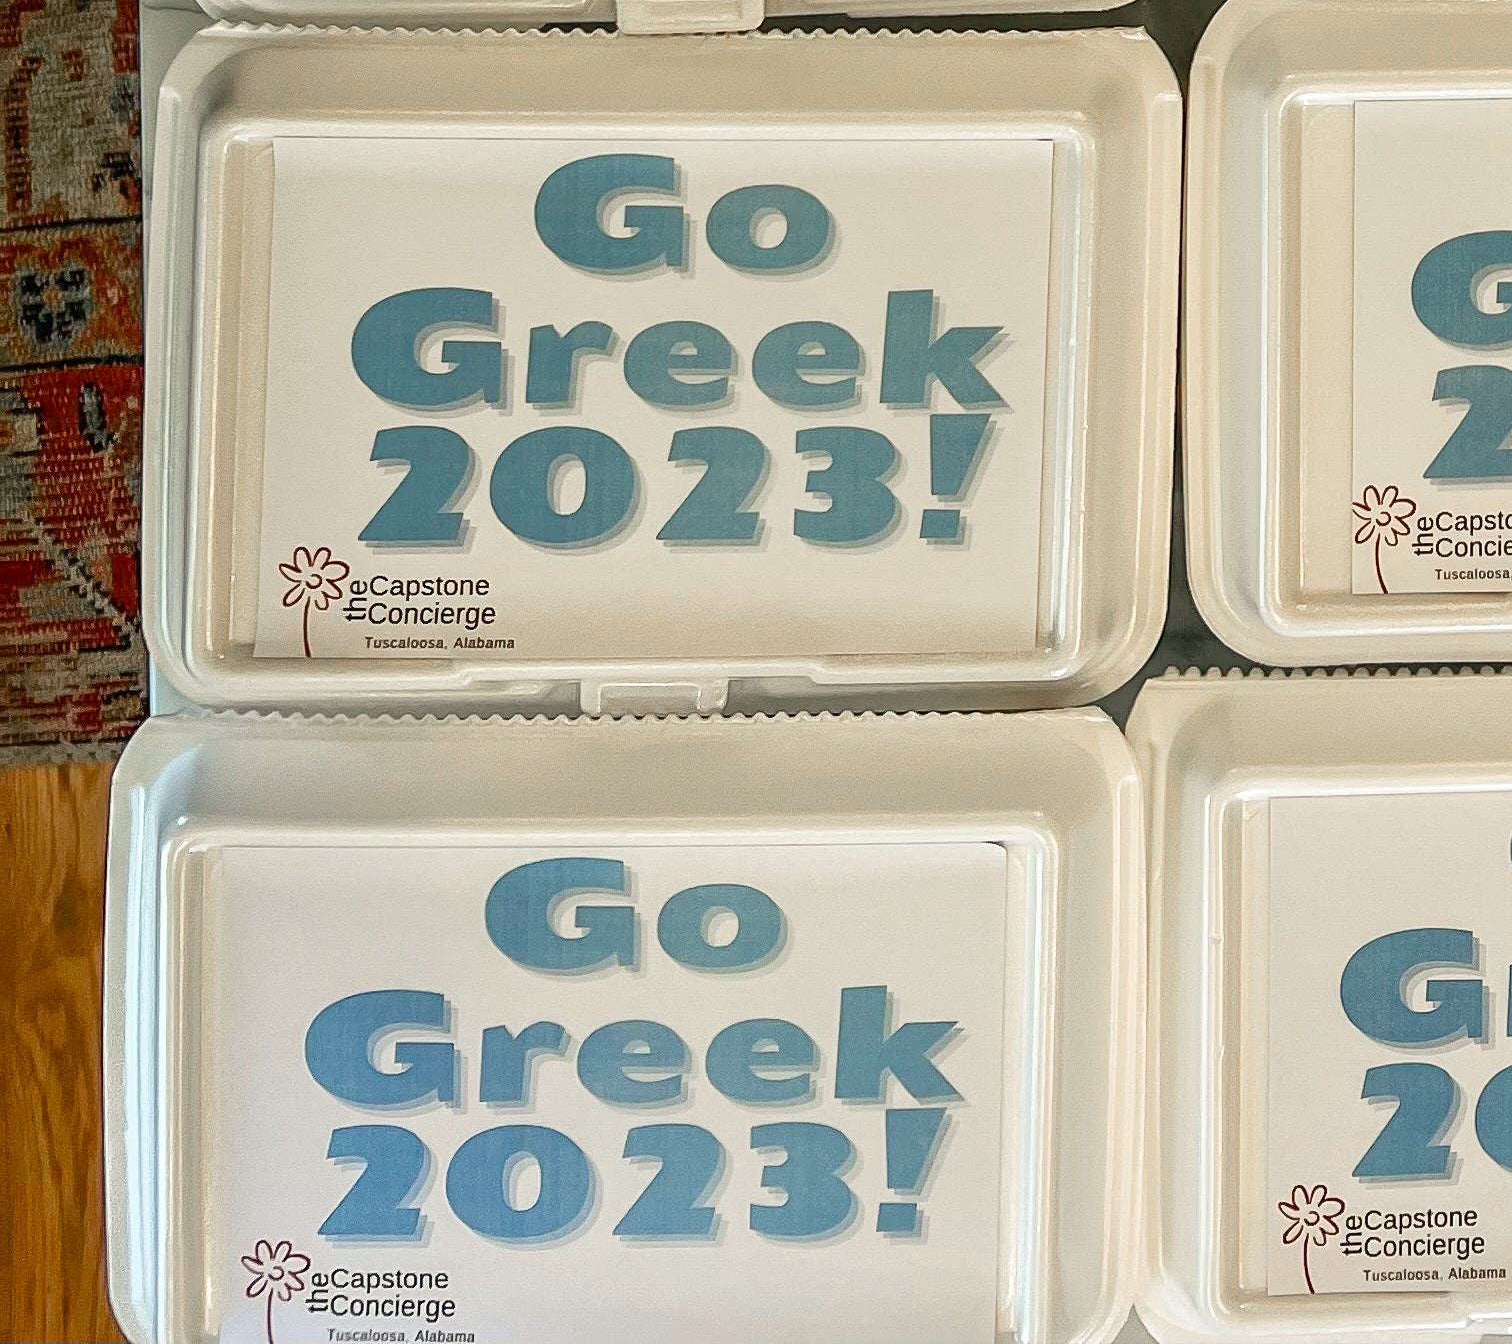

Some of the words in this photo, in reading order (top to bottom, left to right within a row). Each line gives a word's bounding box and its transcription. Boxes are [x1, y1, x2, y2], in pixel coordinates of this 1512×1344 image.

[534, 154, 836, 276] Go
[351, 287, 1009, 412] Greek
[358, 413, 994, 550] 2023!
[1411, 516, 1434, 557] the
[342, 579, 369, 622] the
[369, 575, 490, 602] Capstone
[367, 601, 497, 631] Concierge
[452, 636, 515, 650] Alabama
[485, 857, 788, 976] Go
[305, 985, 964, 1111] Greek
[317, 1107, 951, 1244] 2023!
[1339, 1215, 1363, 1257] the
[1364, 1208, 1478, 1235] Capstone
[1363, 1233, 1485, 1261] Concierge
[304, 1272, 330, 1314] the
[330, 1267, 449, 1295] Capstone
[1447, 1266, 1507, 1280] Alabama
[330, 1293, 456, 1324] Concierge
[414, 1329, 475, 1344] Alabama
